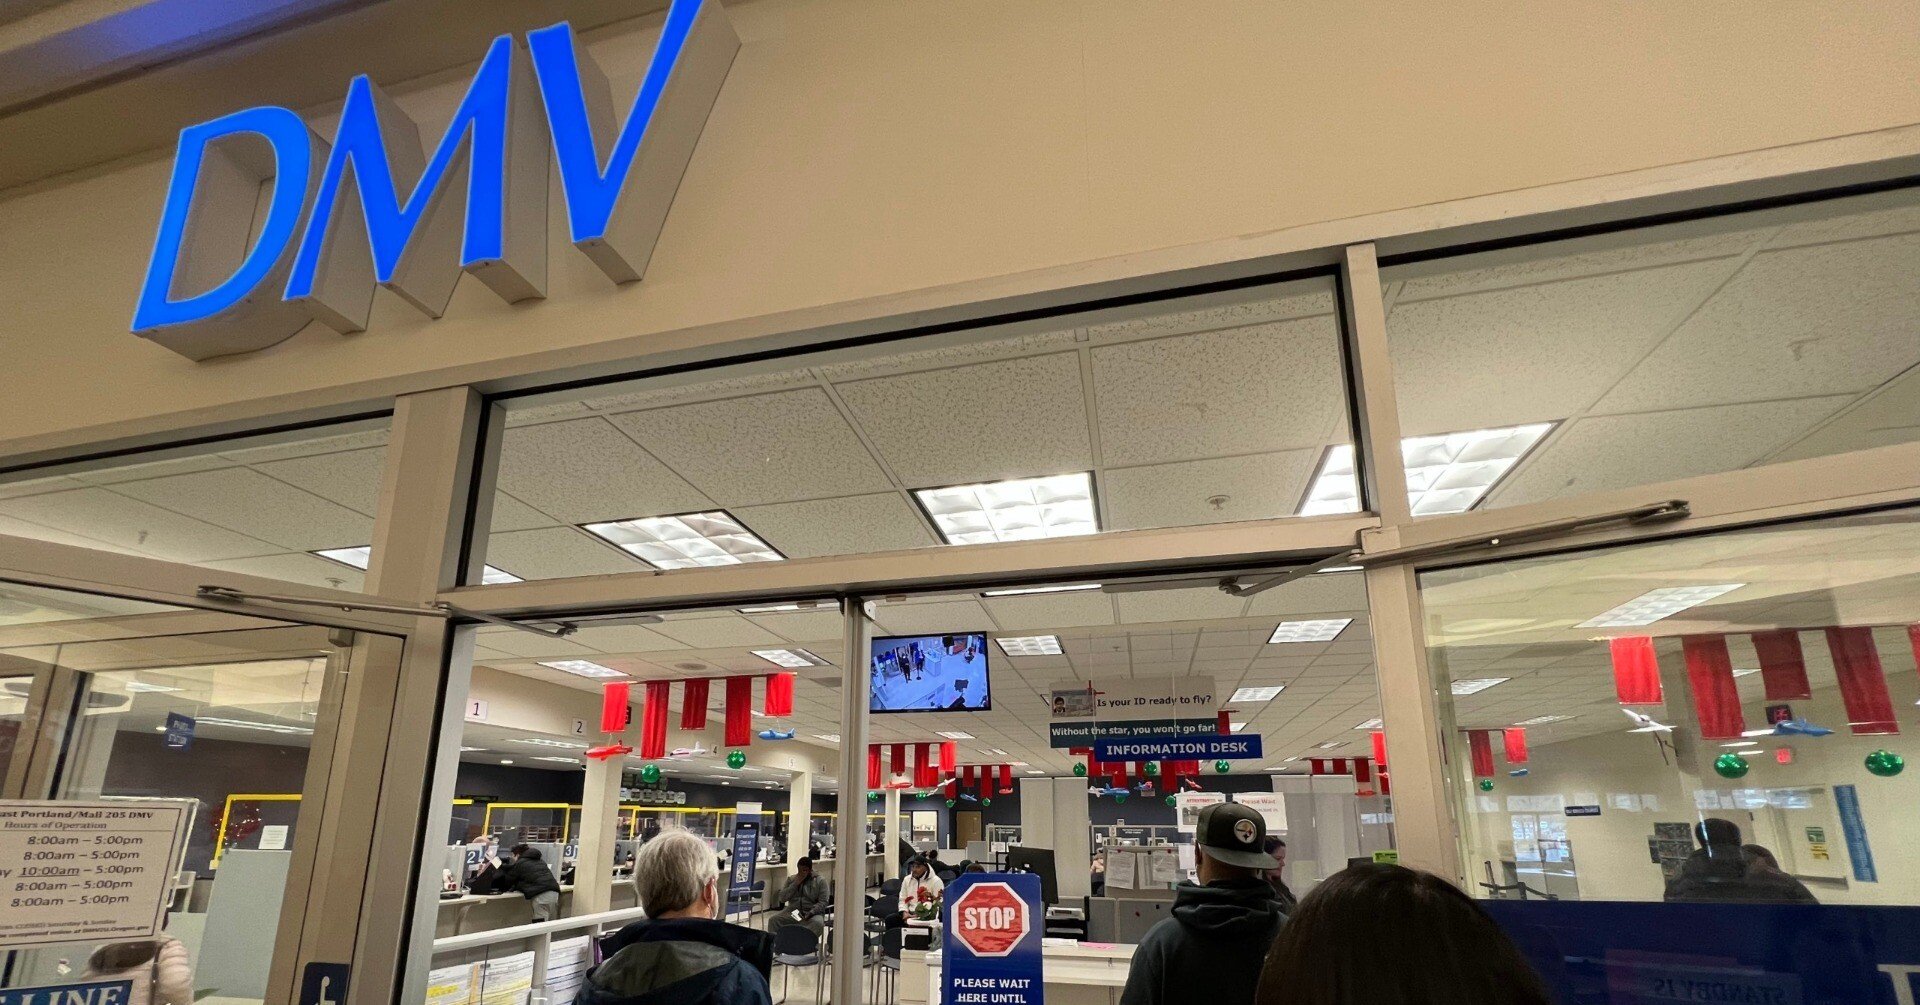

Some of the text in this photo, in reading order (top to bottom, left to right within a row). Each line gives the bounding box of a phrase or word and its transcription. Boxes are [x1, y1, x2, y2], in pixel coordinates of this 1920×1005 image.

[131, 0, 702, 333] DMV
[1097, 694, 1211, 709] Is your ID ready to fly?
[473, 702, 480, 716] 1
[576, 720, 583, 734] 2
[1051, 726, 1089, 736] Without
[1091, 725, 1107, 735] the
[1109, 726, 1131, 736] star,
[1132, 726, 1151, 737] you
[1183, 726, 1196, 735] go
[1197, 724, 1216, 733] far!
[1106, 742, 1248, 756] INFORMATION DESK
[21, 810, 102, 819] Portland/Mall
[105, 811, 126, 819] 205
[4, 821, 107, 831] Hours of Operation
[27, 835, 79, 845] 8:00am
[94, 835, 143, 846] 5:00pm
[23, 851, 75, 861] 8:00am
[91, 850, 140, 860] 5:00pm
[565, 845, 572, 856] 3
[466, 851, 476, 864] 2
[20, 866, 80, 877] 10:00am
[95, 865, 144, 875] 5:00pm
[15, 881, 67, 892] 8:00am
[83, 880, 133, 890] 5:00pm
[11, 897, 63, 908] 8:00am
[80, 894, 129, 905] 5:00pm
[964, 906, 1016, 930] STOP
[954, 978, 1031, 989] PLEASE WAIT
[957, 993, 1027, 1004] HERE UNTIL
